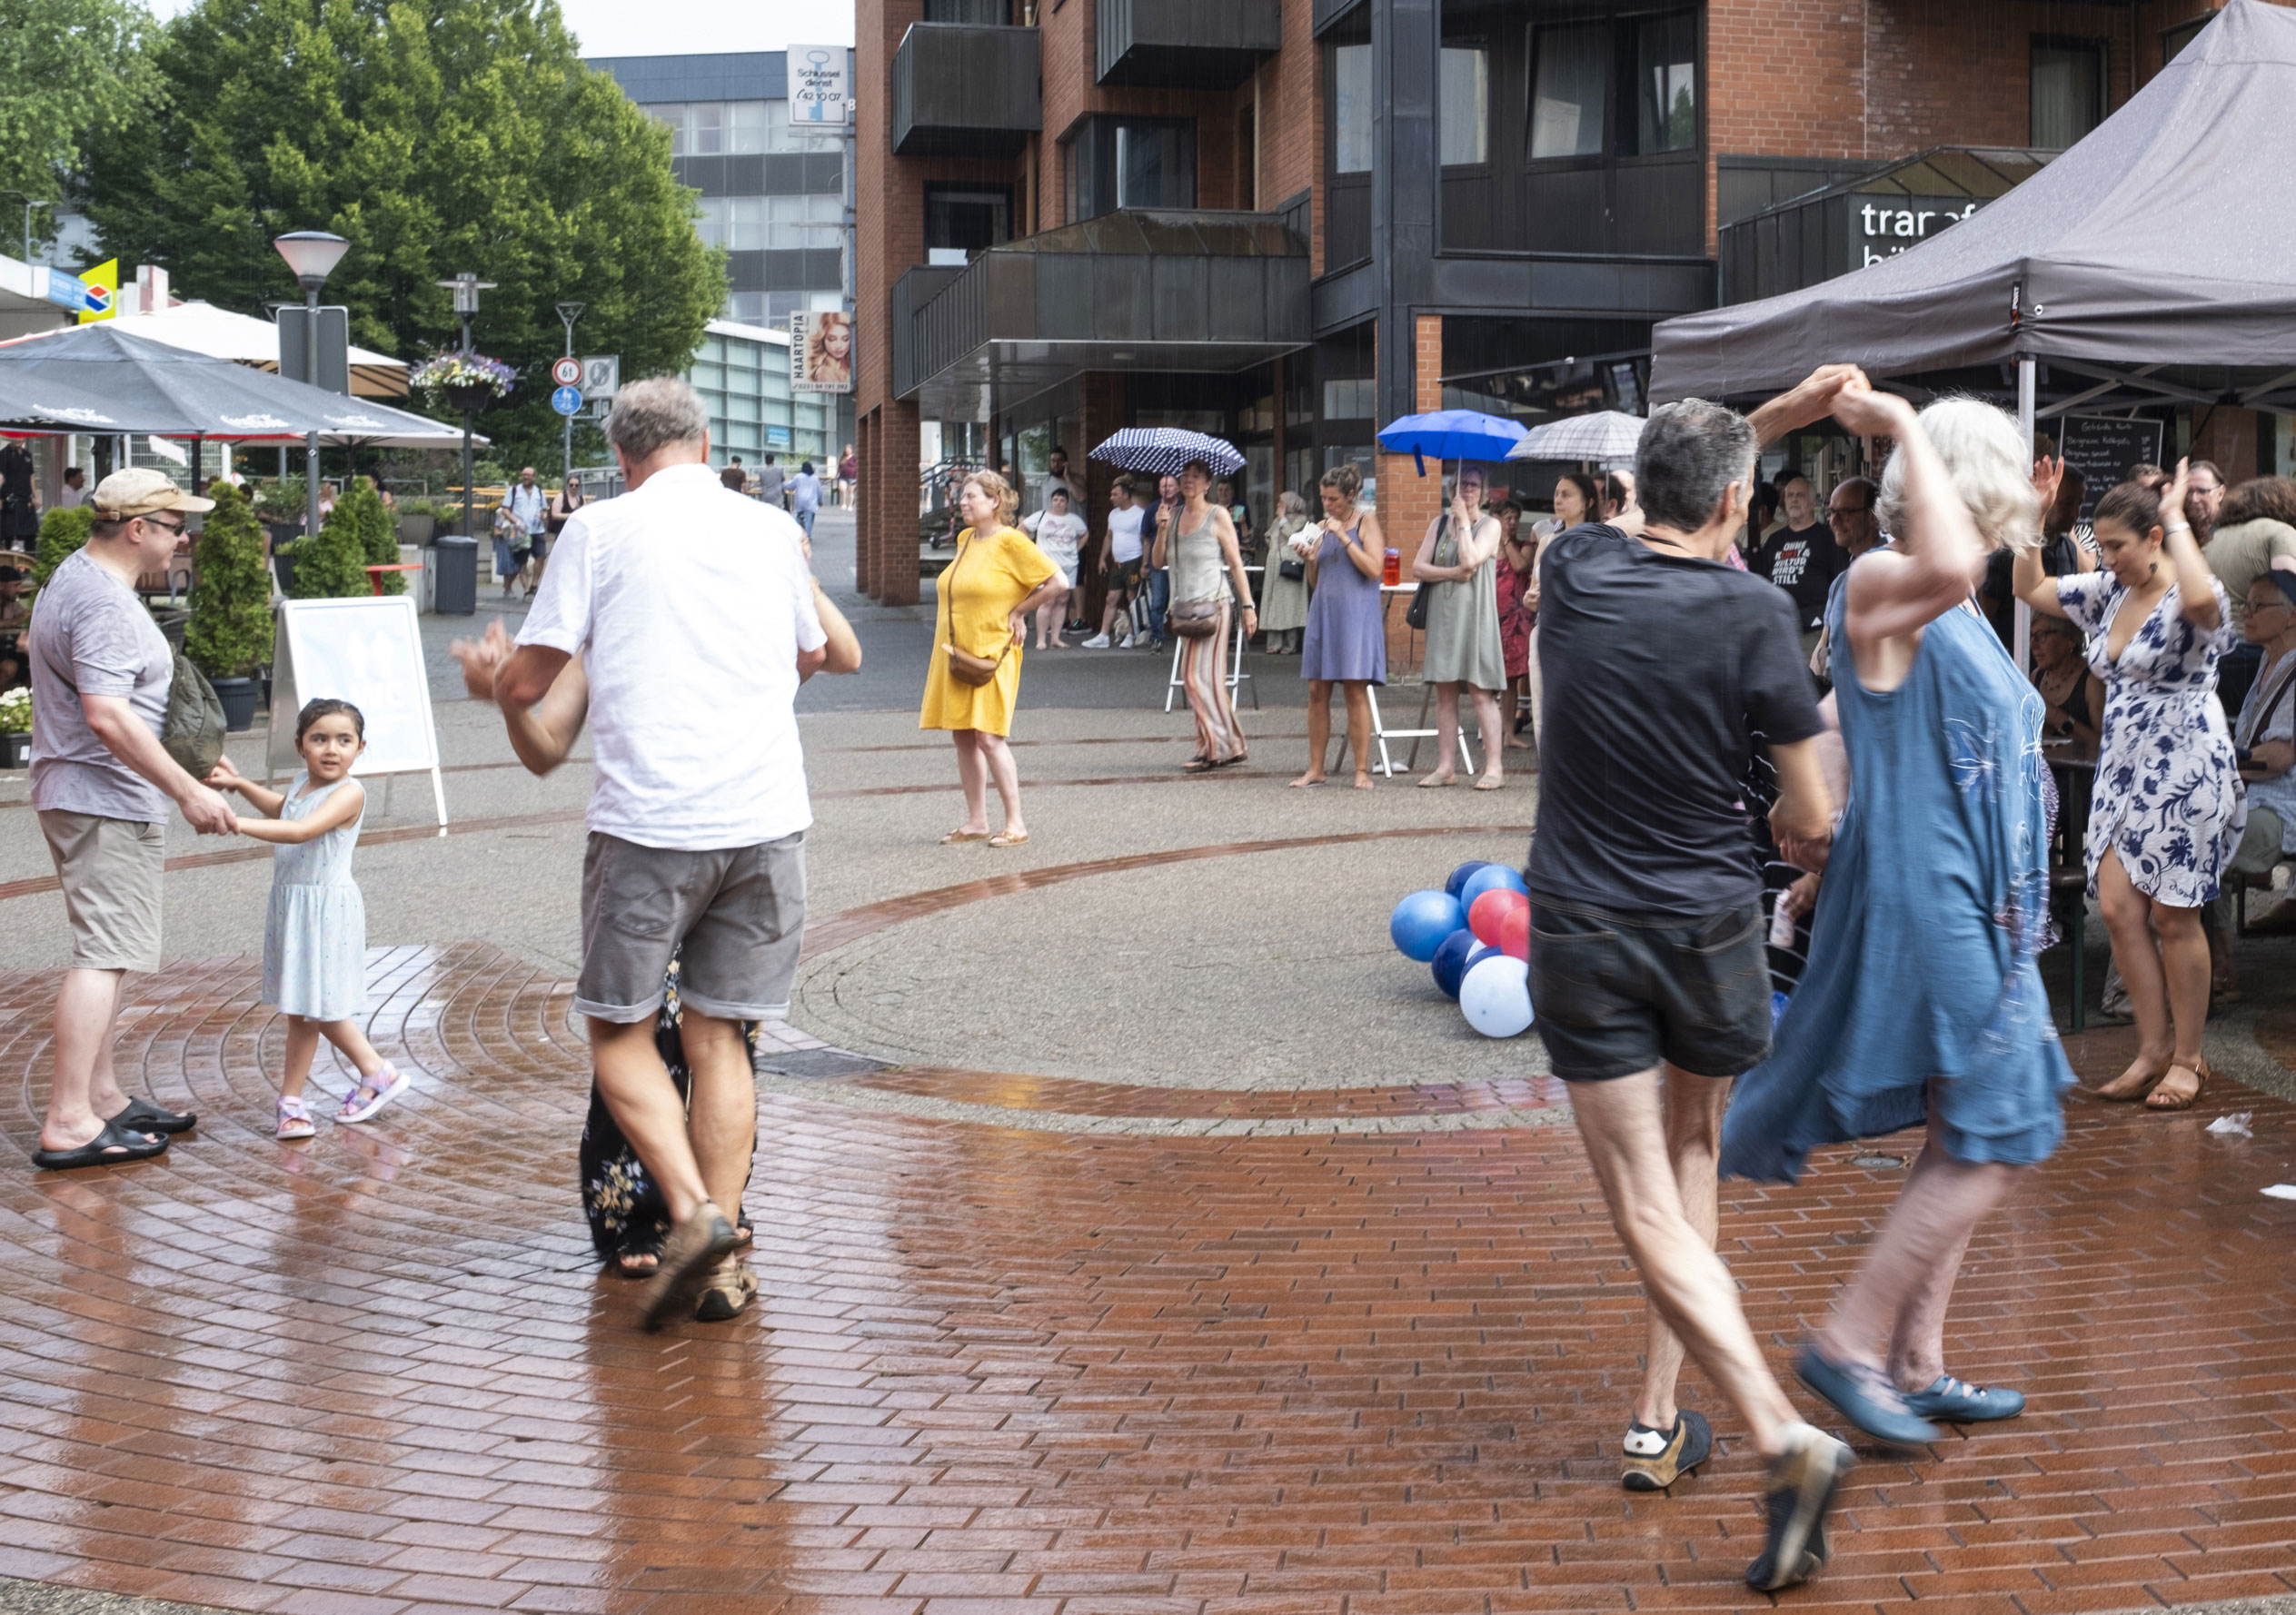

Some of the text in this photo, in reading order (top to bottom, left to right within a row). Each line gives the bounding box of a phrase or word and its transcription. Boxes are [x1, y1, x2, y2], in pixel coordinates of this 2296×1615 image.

[802, 92, 841, 102] 42 10 07
[793, 314, 804, 379] HAARTOPIA
[1783, 540, 1807, 551] OHNE
[1774, 557, 1807, 568] KULTUR
[1773, 573, 1799, 586] STILL
